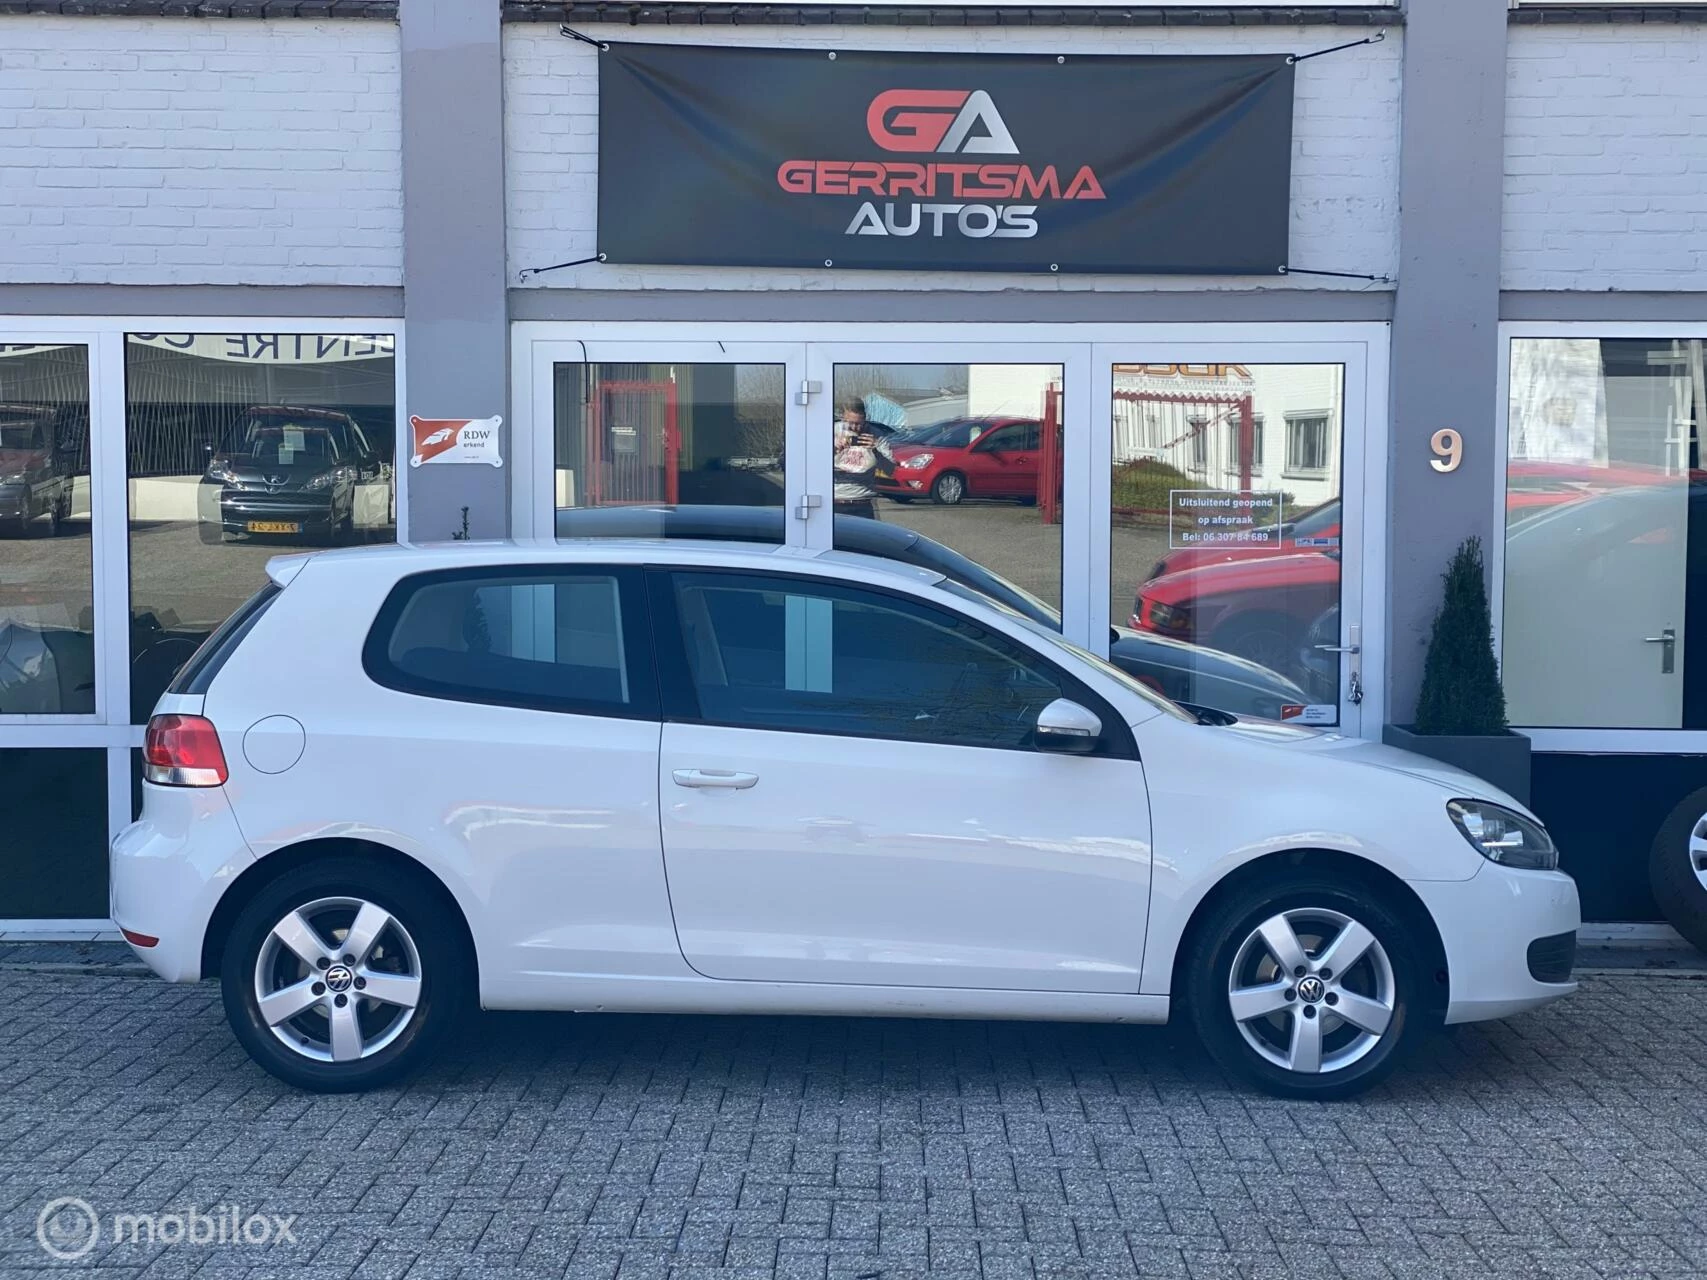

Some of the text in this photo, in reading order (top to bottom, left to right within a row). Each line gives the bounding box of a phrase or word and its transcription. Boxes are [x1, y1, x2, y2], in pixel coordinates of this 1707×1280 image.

[866, 88, 1020, 155] GA
[777, 159, 1106, 200] GERRITSMA
[845, 201, 1038, 238] AUTO'S
[463, 430, 491, 440] RDW
[1429, 428, 1463, 473] 9
[1179, 497, 1273, 509] Uitsluitend geopend
[1198, 515, 1254, 526] op afspraak
[1182, 532, 1201, 541] Bel:
[1203, 532, 1215, 541] 06
[1217, 532, 1234, 541] 307
[1251, 532, 1269, 541] 689
